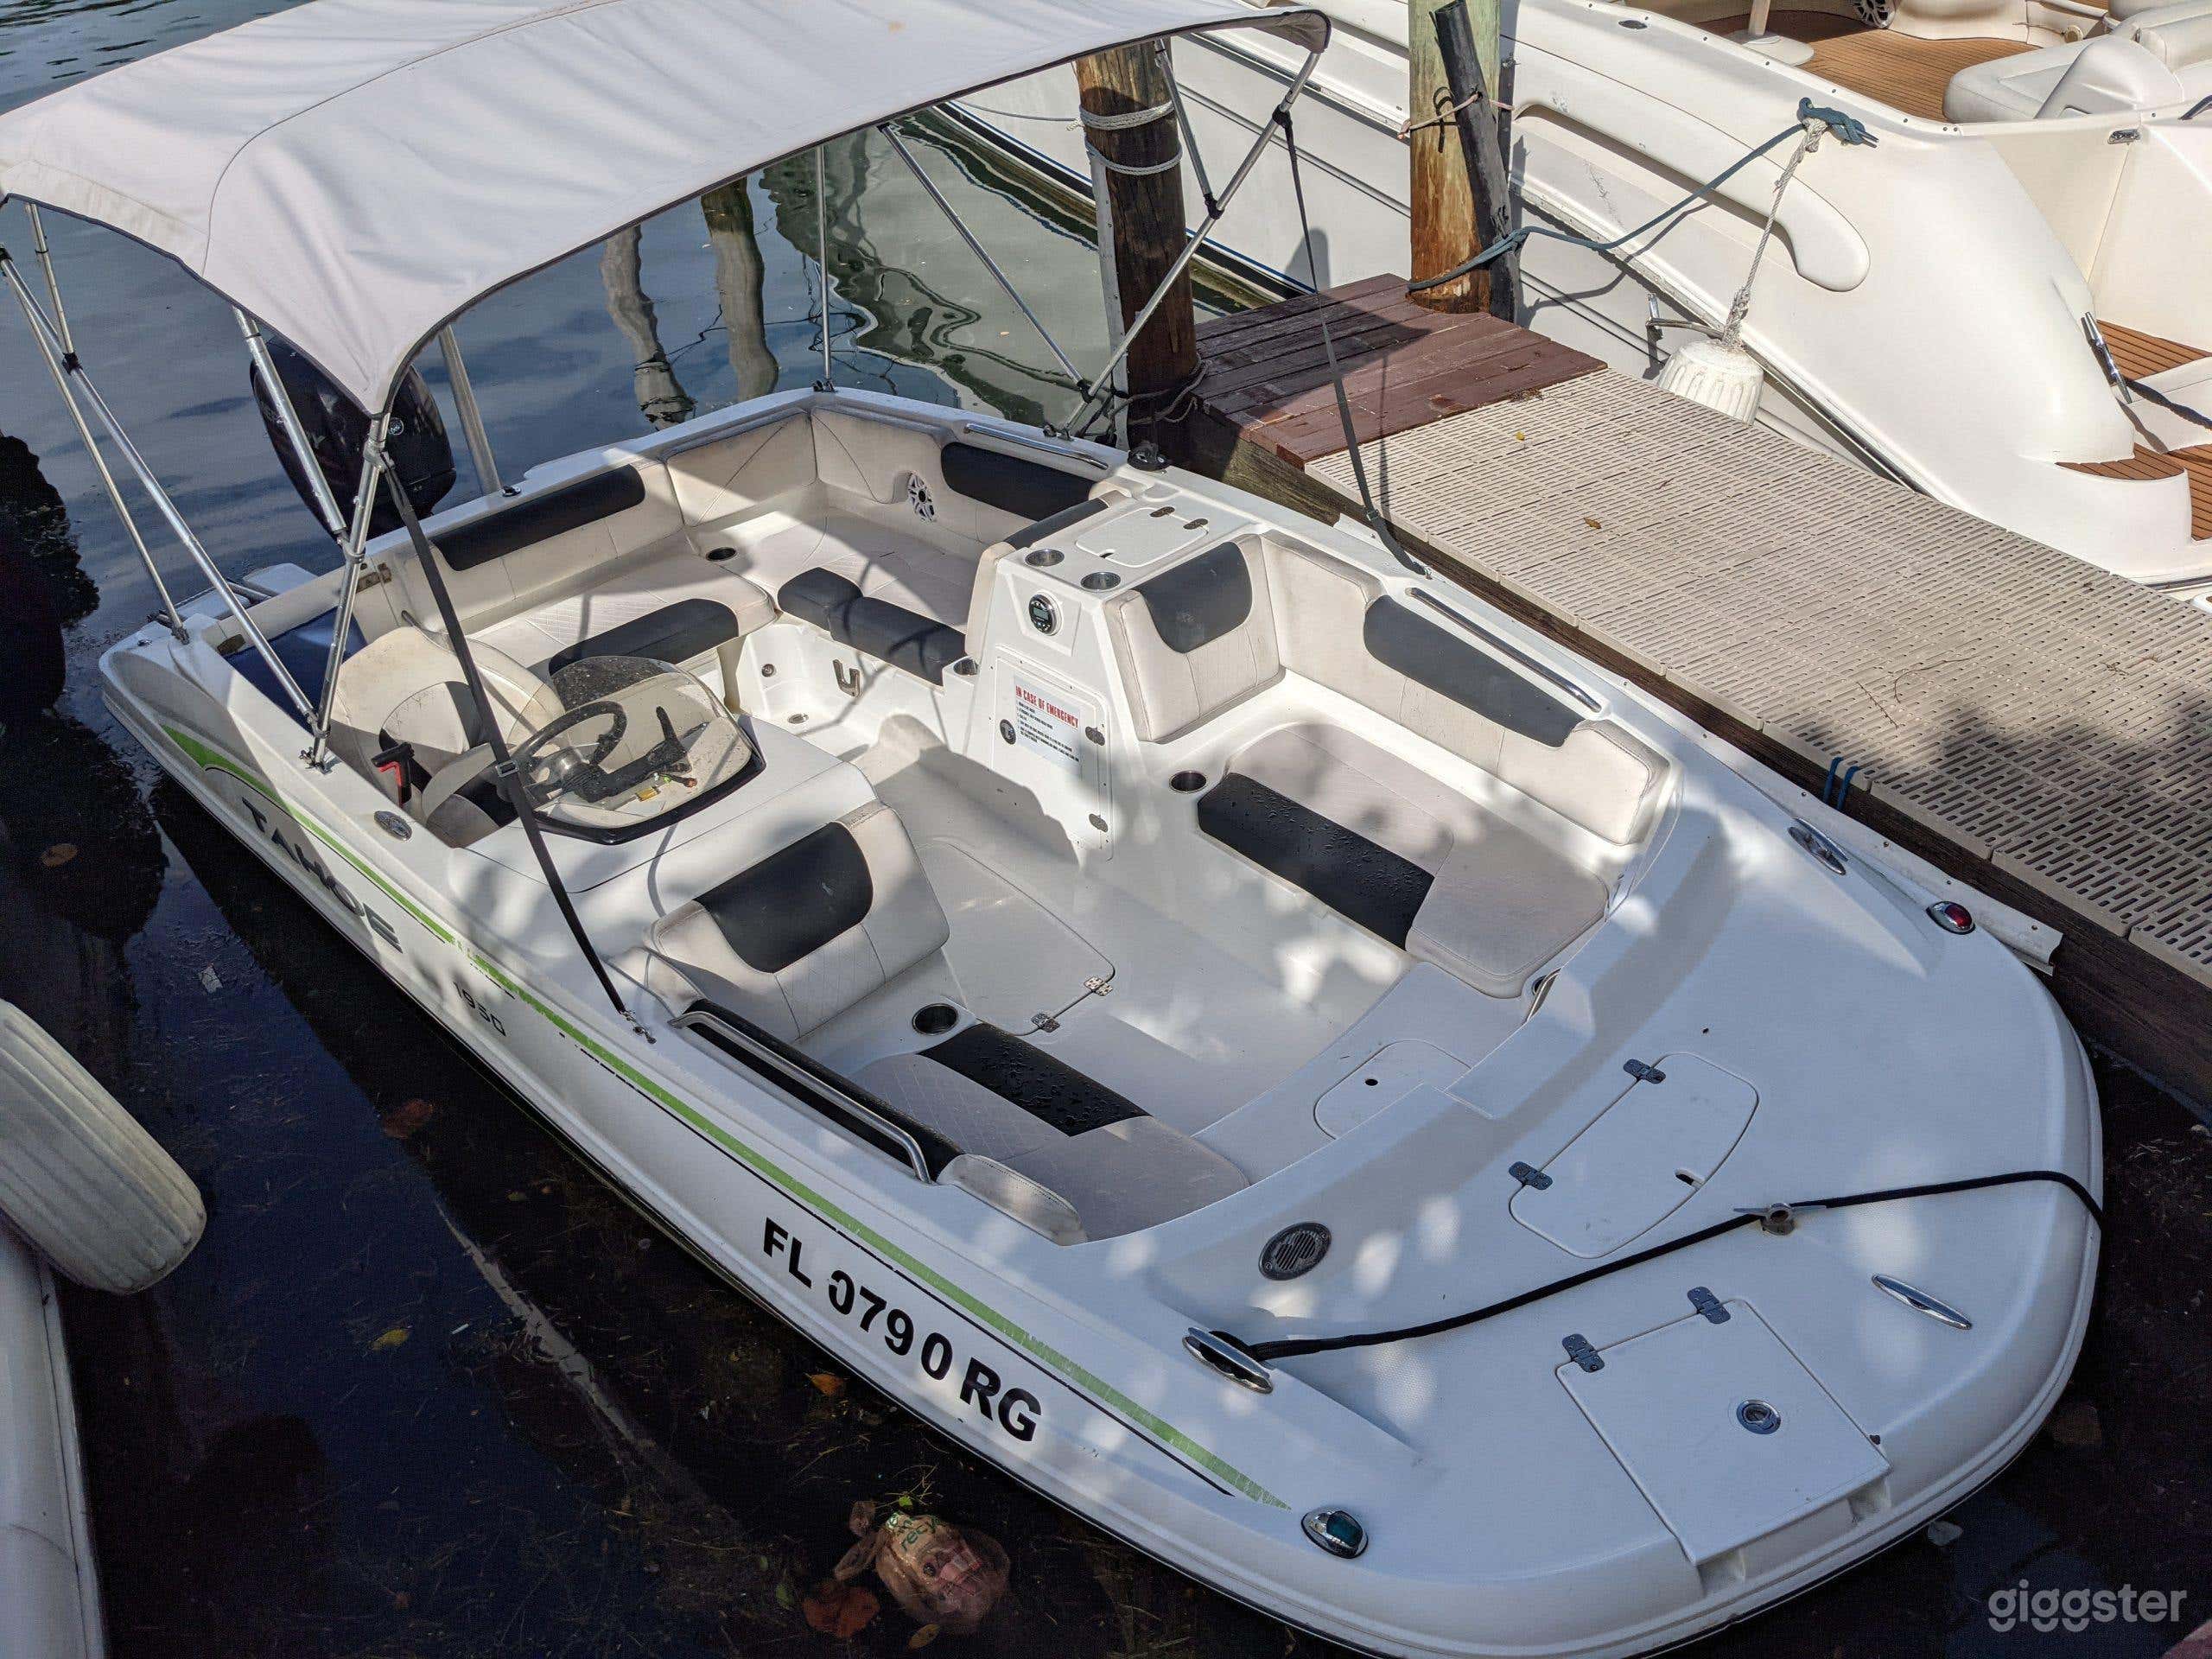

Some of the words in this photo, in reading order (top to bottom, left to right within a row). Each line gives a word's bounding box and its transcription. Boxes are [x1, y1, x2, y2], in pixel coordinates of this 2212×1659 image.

[1015, 684, 1022, 698] IN
[1023, 690, 1037, 707] CASE
[1038, 697, 1046, 710] OF
[1046, 702, 1078, 728] EMERGENCY
[241, 796, 404, 955] TAHOE
[453, 981, 506, 1037] 1950
[763, 1216, 812, 1289] FL
[827, 1269, 954, 1381] 0790
[959, 1357, 1042, 1442] RG
